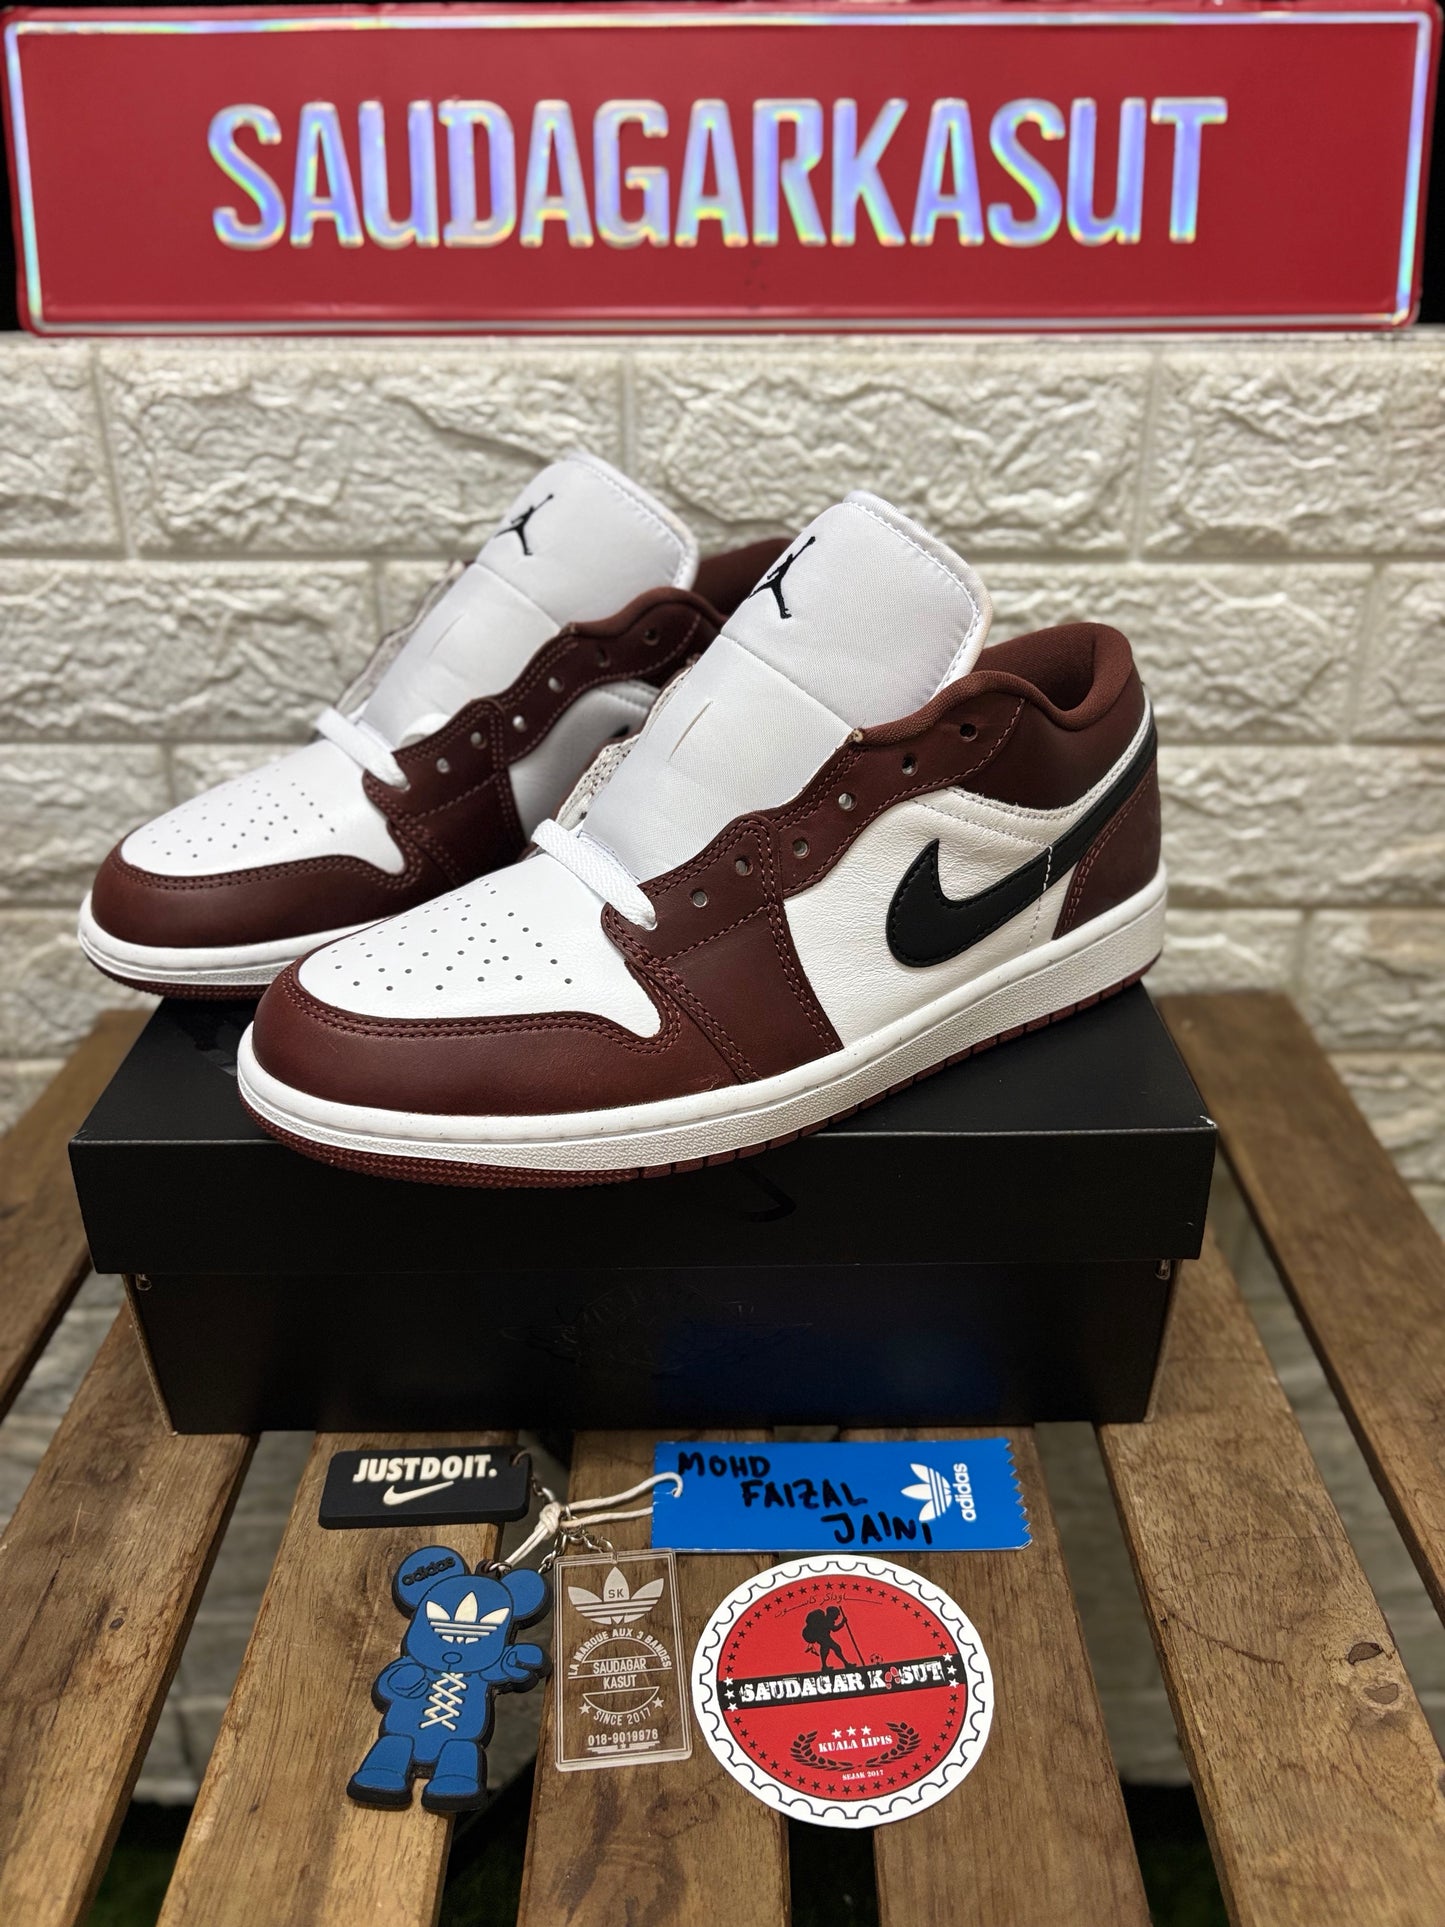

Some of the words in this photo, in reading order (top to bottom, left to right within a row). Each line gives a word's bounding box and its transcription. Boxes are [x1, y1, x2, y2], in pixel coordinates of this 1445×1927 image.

[208, 97, 1228, 250] SAUDAGARKASUT
[678, 1452, 770, 1478] MOHD
[740, 1478, 868, 1509] FAIZAL
[953, 1462, 977, 1522] adidas
[820, 1511, 932, 1545] JAINI
[402, 1556, 456, 1586] adidas
[608, 1588, 624, 1598] SK
[612, 1628, 633, 1637] AUX
[636, 1631, 644, 1639] 3
[573, 1631, 609, 1661] MARQUE
[644, 1635, 672, 1667] BANDES
[568, 1664, 580, 1675] LA
[593, 1658, 647, 1674] SAUDAGAR
[603, 1675, 637, 1689] KASUT
[740, 1673, 865, 1702] SAUDAGAR
[593, 1710, 622, 1726] SINCE
[627, 1707, 651, 1724] 2017
[818, 1739, 858, 1752] KUALA
[861, 1735, 893, 1747] LIPIS
[842, 1772, 865, 1781] SEJAK
[867, 1769, 884, 1778] 2017
